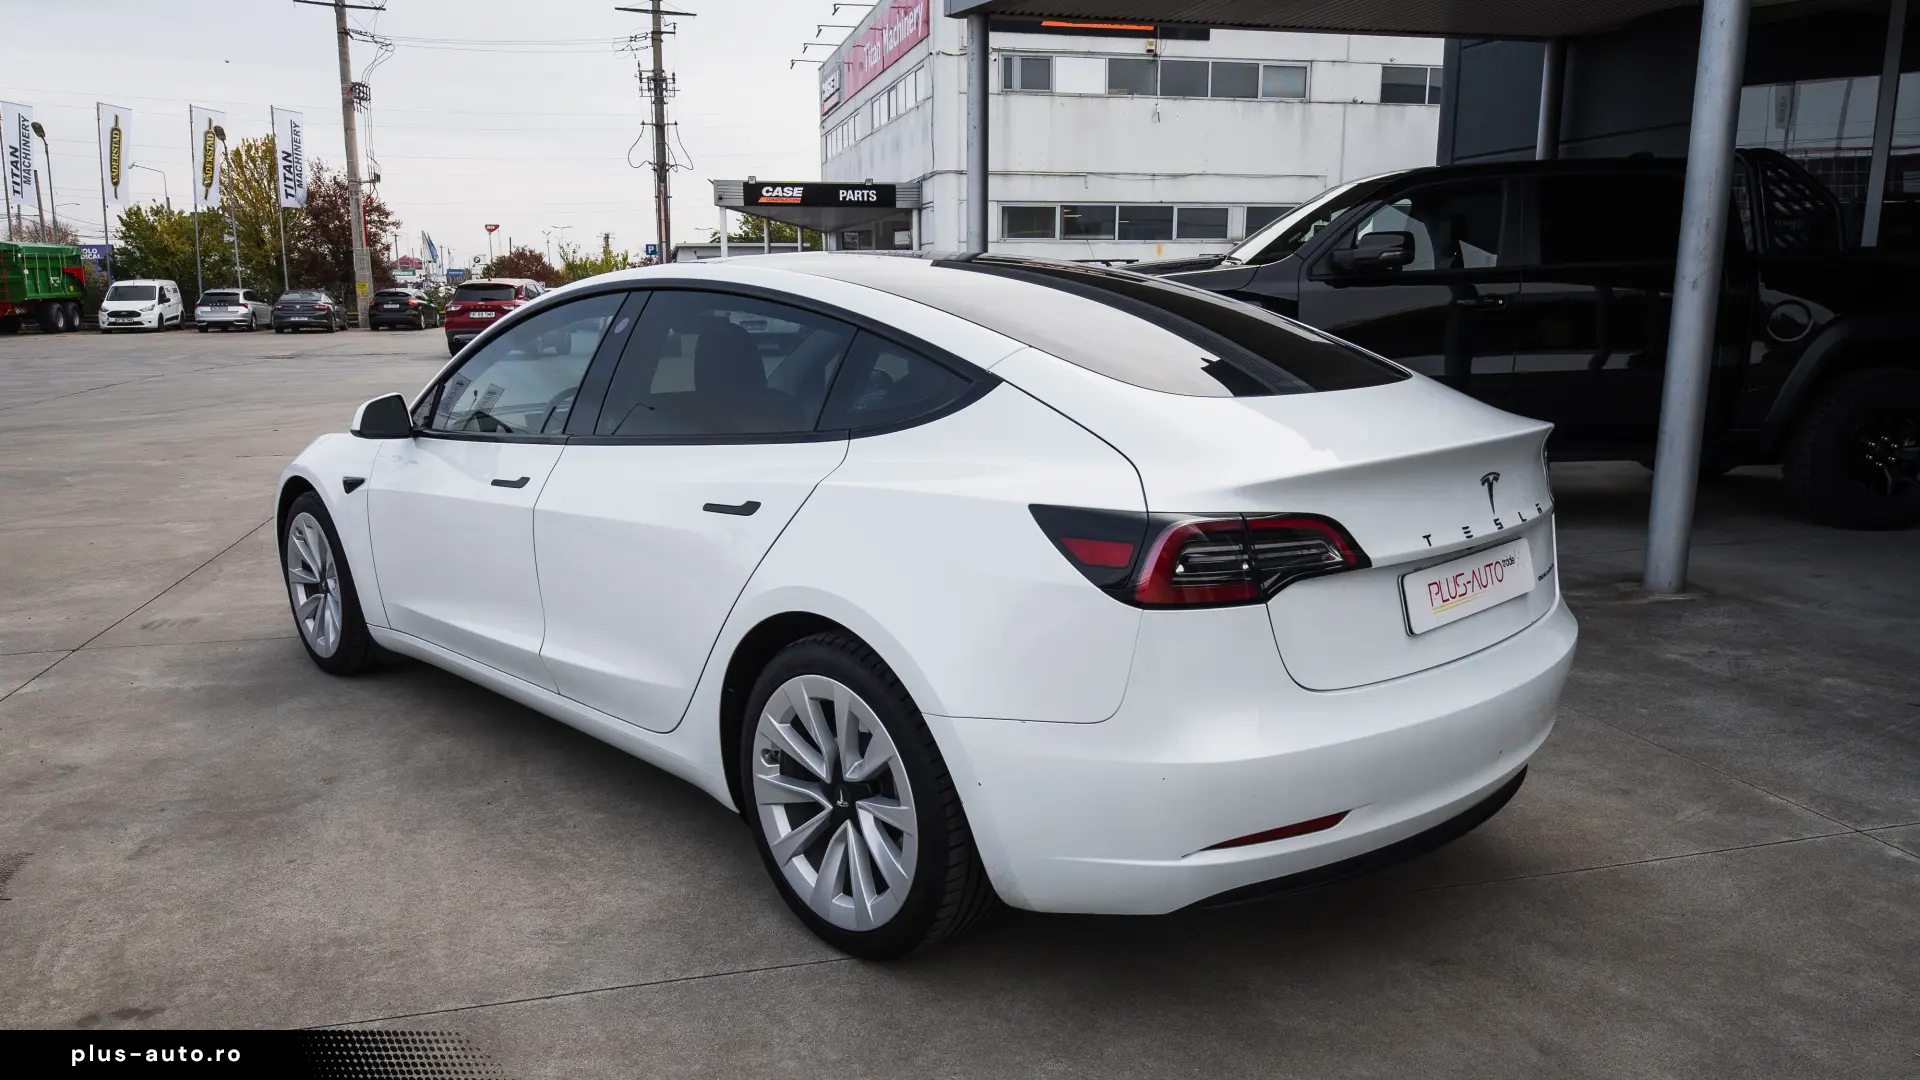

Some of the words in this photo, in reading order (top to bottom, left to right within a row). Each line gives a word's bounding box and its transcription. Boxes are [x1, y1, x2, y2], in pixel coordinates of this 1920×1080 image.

[864, 41, 881, 72] Titan
[883, 1, 923, 54] Machinery
[9, 145, 21, 196] TITAN
[21, 115, 32, 185] MACHINERY
[111, 131, 121, 183] VÄDERSTAD
[203, 134, 214, 184] VÄDERSTAD
[282, 150, 294, 199] TITAN
[293, 121, 304, 189] MACHINERY
[762, 186, 804, 197] CASE
[839, 190, 877, 201] PARTS
[1422, 503, 1543, 547] TESLA
[1427, 561, 1504, 607] PLUS-AUTO
[1501, 555, 1516, 568] trade
